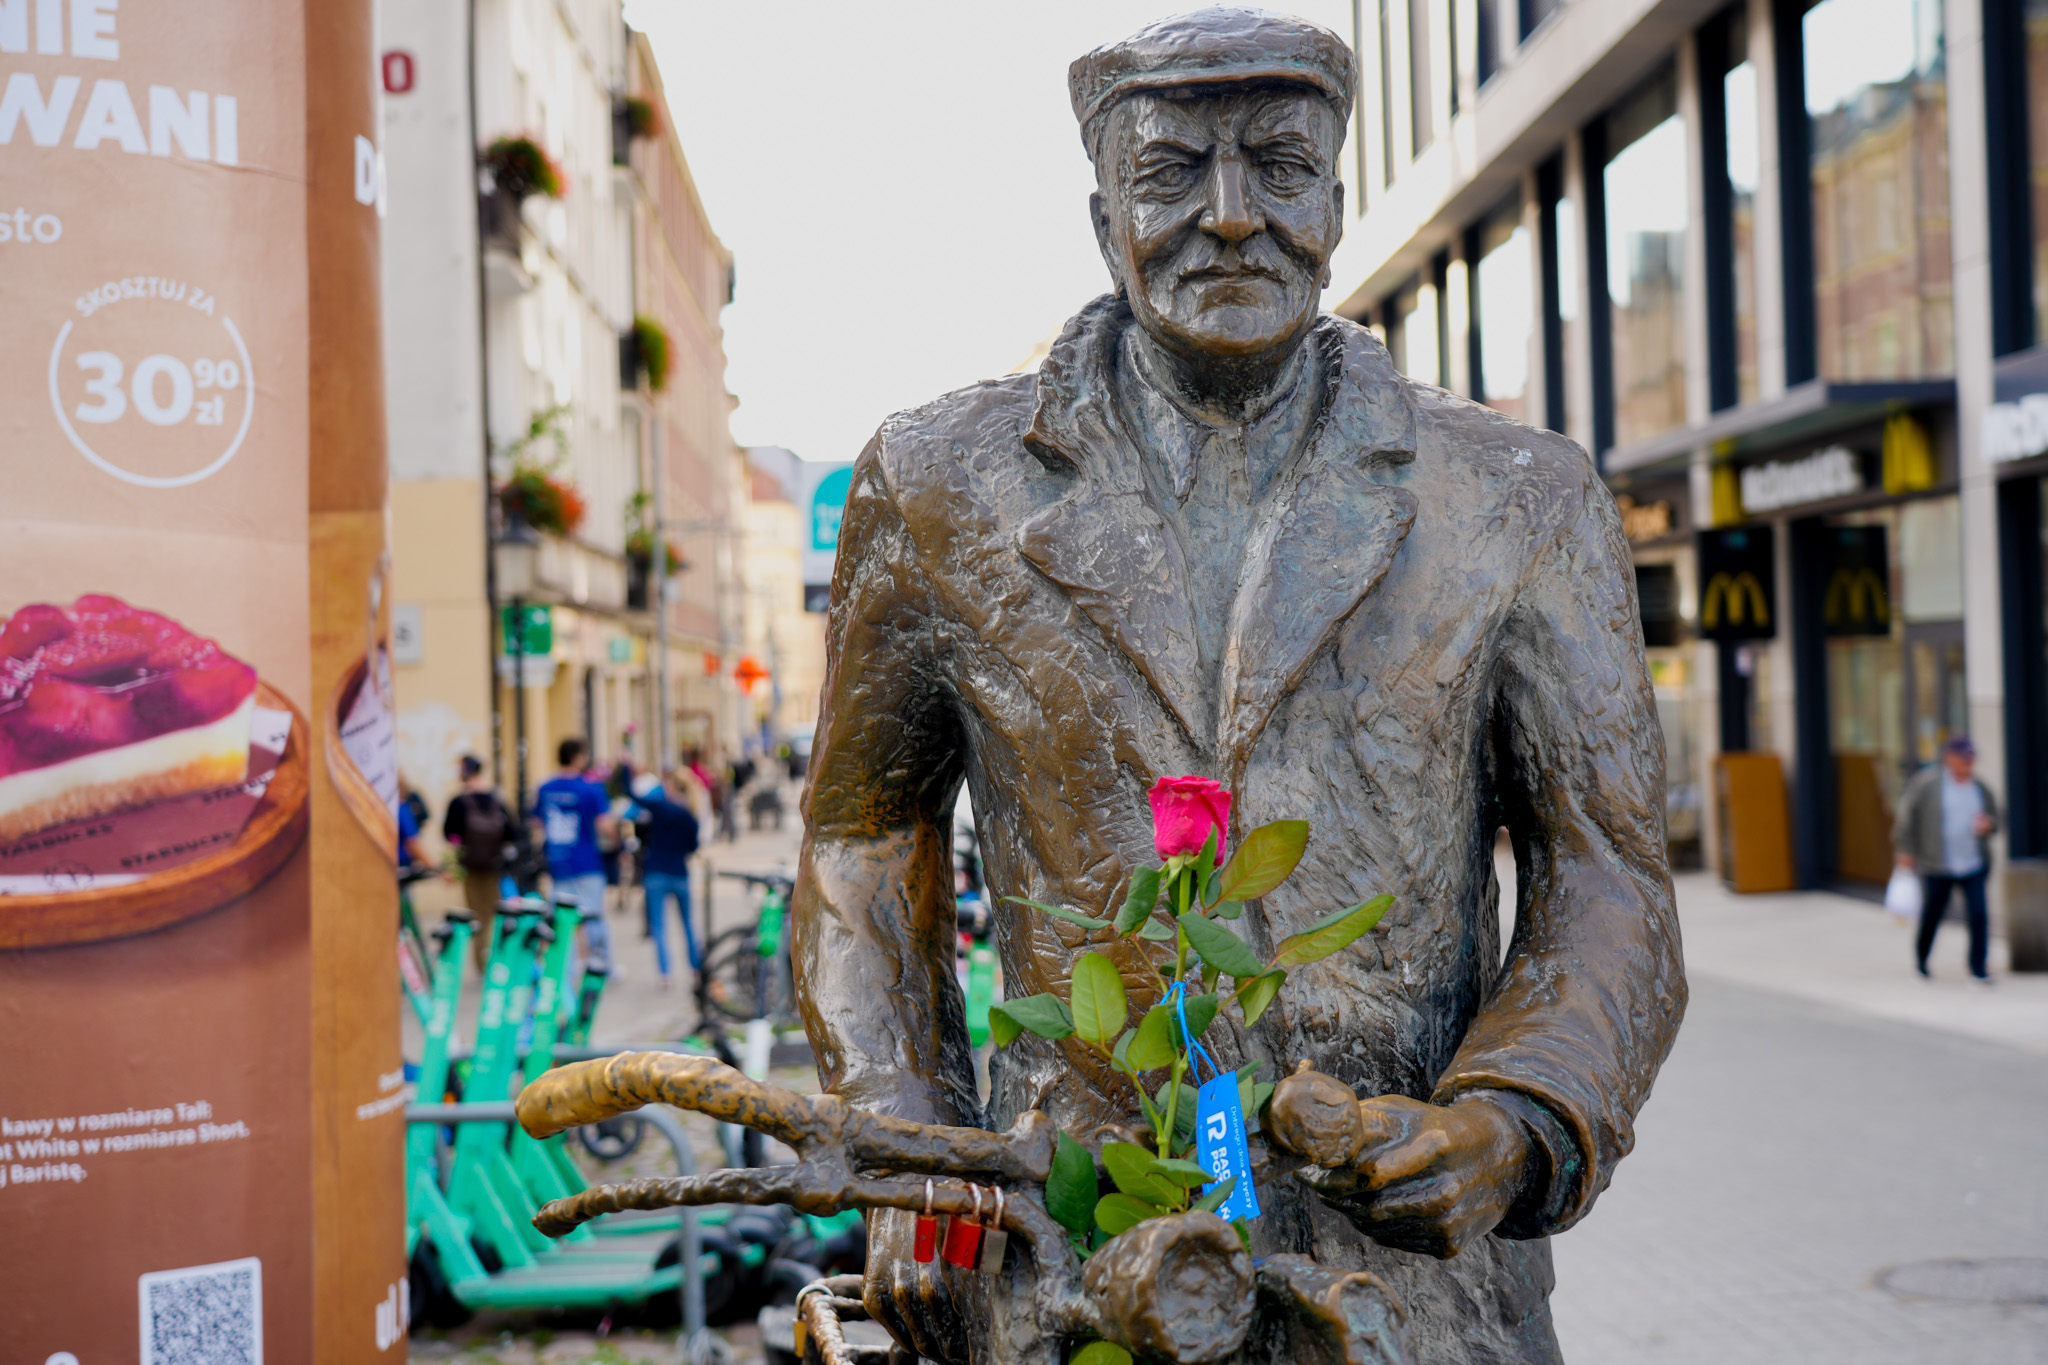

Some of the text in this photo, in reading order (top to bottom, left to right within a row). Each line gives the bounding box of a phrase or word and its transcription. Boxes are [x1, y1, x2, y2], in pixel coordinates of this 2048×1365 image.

[75, 276, 215, 317] SKOSZTUJ ZA
[76, 350, 240, 426] 30 90
[2, 1116, 54, 1139] kawy
[57, 1117, 76, 1134] w
[79, 1107, 174, 1132] rozmiarze
[15, 1136, 80, 1160] White
[81, 1138, 101, 1155] w
[103, 1128, 196, 1154] rozmiarze
